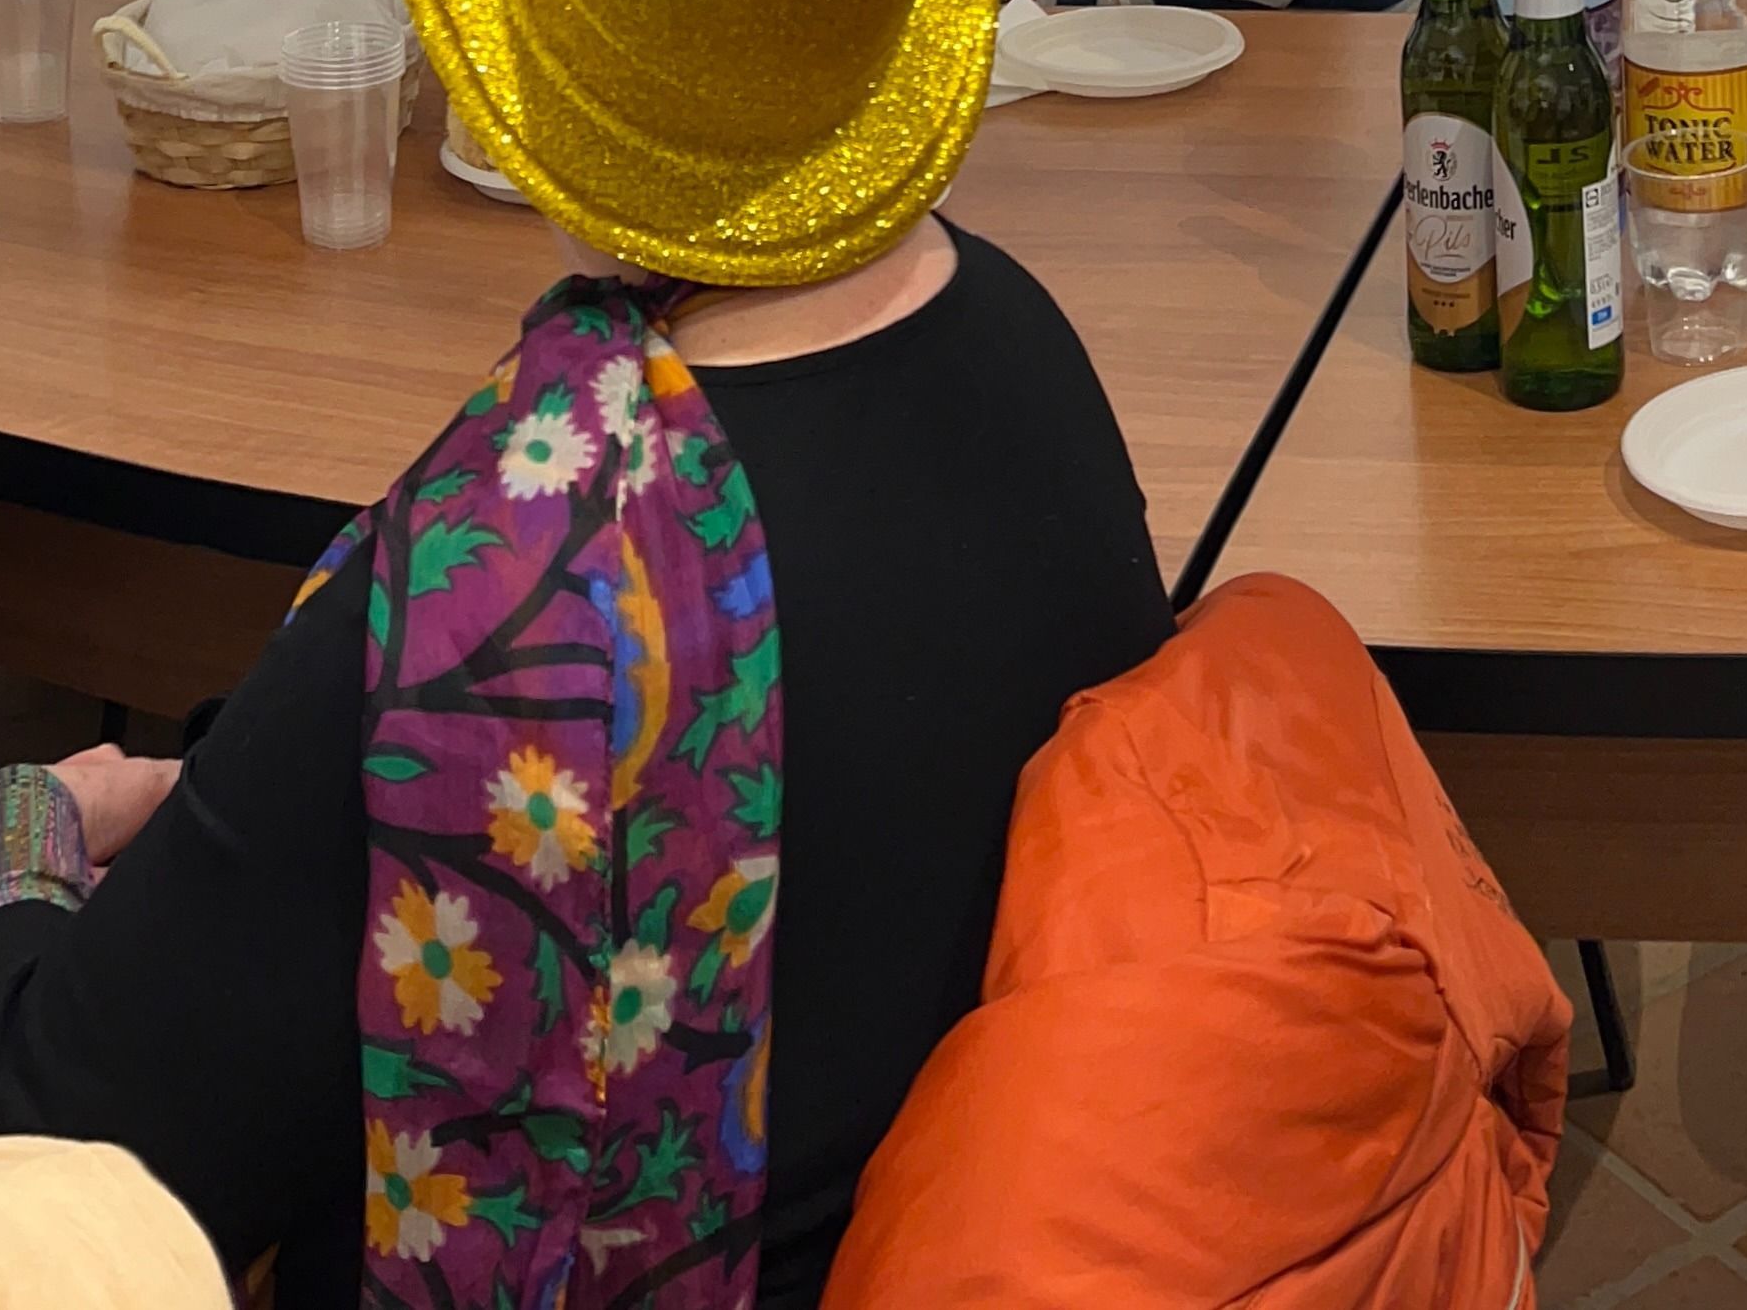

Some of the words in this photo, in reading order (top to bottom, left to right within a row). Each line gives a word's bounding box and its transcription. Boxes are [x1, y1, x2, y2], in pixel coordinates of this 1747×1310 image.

[1644, 114, 1731, 140] TONIC
[1645, 141, 1737, 164] WATER
[1416, 215, 1470, 260] Pils
